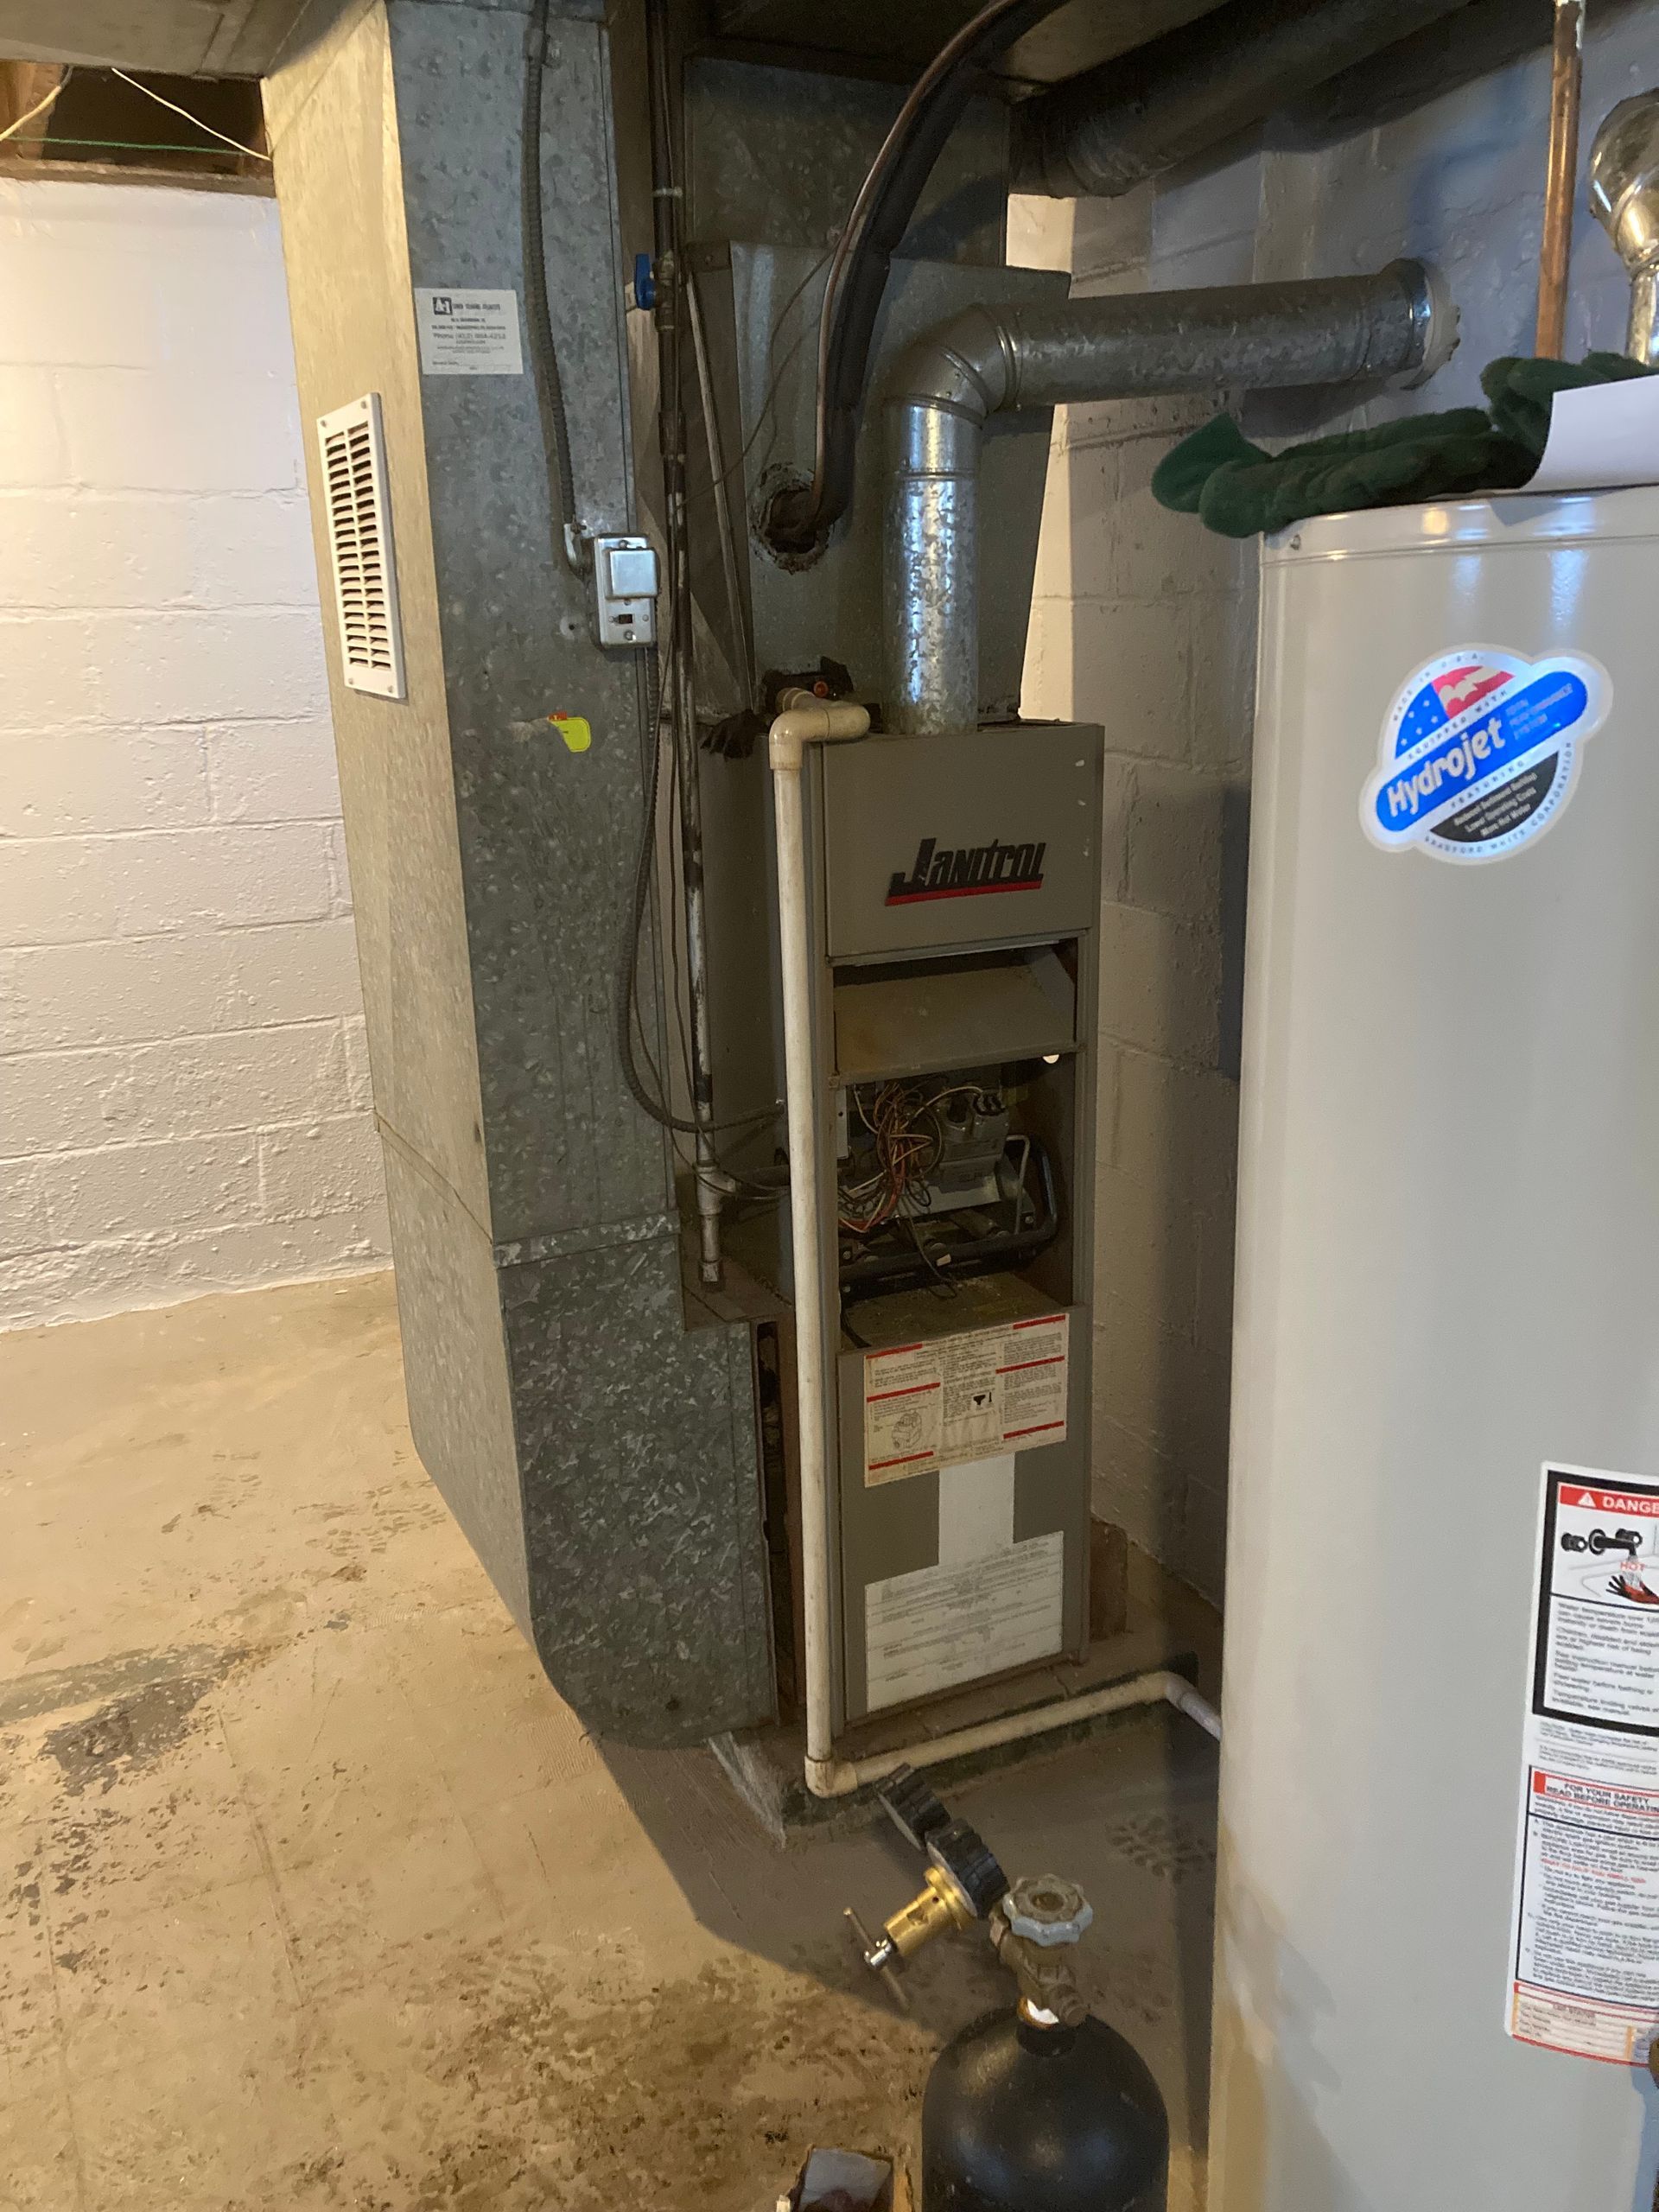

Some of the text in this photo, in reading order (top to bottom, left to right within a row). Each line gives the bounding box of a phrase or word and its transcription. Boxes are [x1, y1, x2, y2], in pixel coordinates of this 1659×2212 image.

[1408, 716, 1467, 760] EQUIPPED
[1475, 690, 1509, 713] WITH
[1387, 717, 1505, 817] Hydrojet
[1451, 760, 1524, 809] FEATURING
[1620, 1561, 1645, 1572] HOT
[1547, 1786, 1572, 1797] READ
[1573, 1792, 1611, 1805] BEFORE
[1564, 1783, 1649, 1804] FOR YOUR SAFETY
